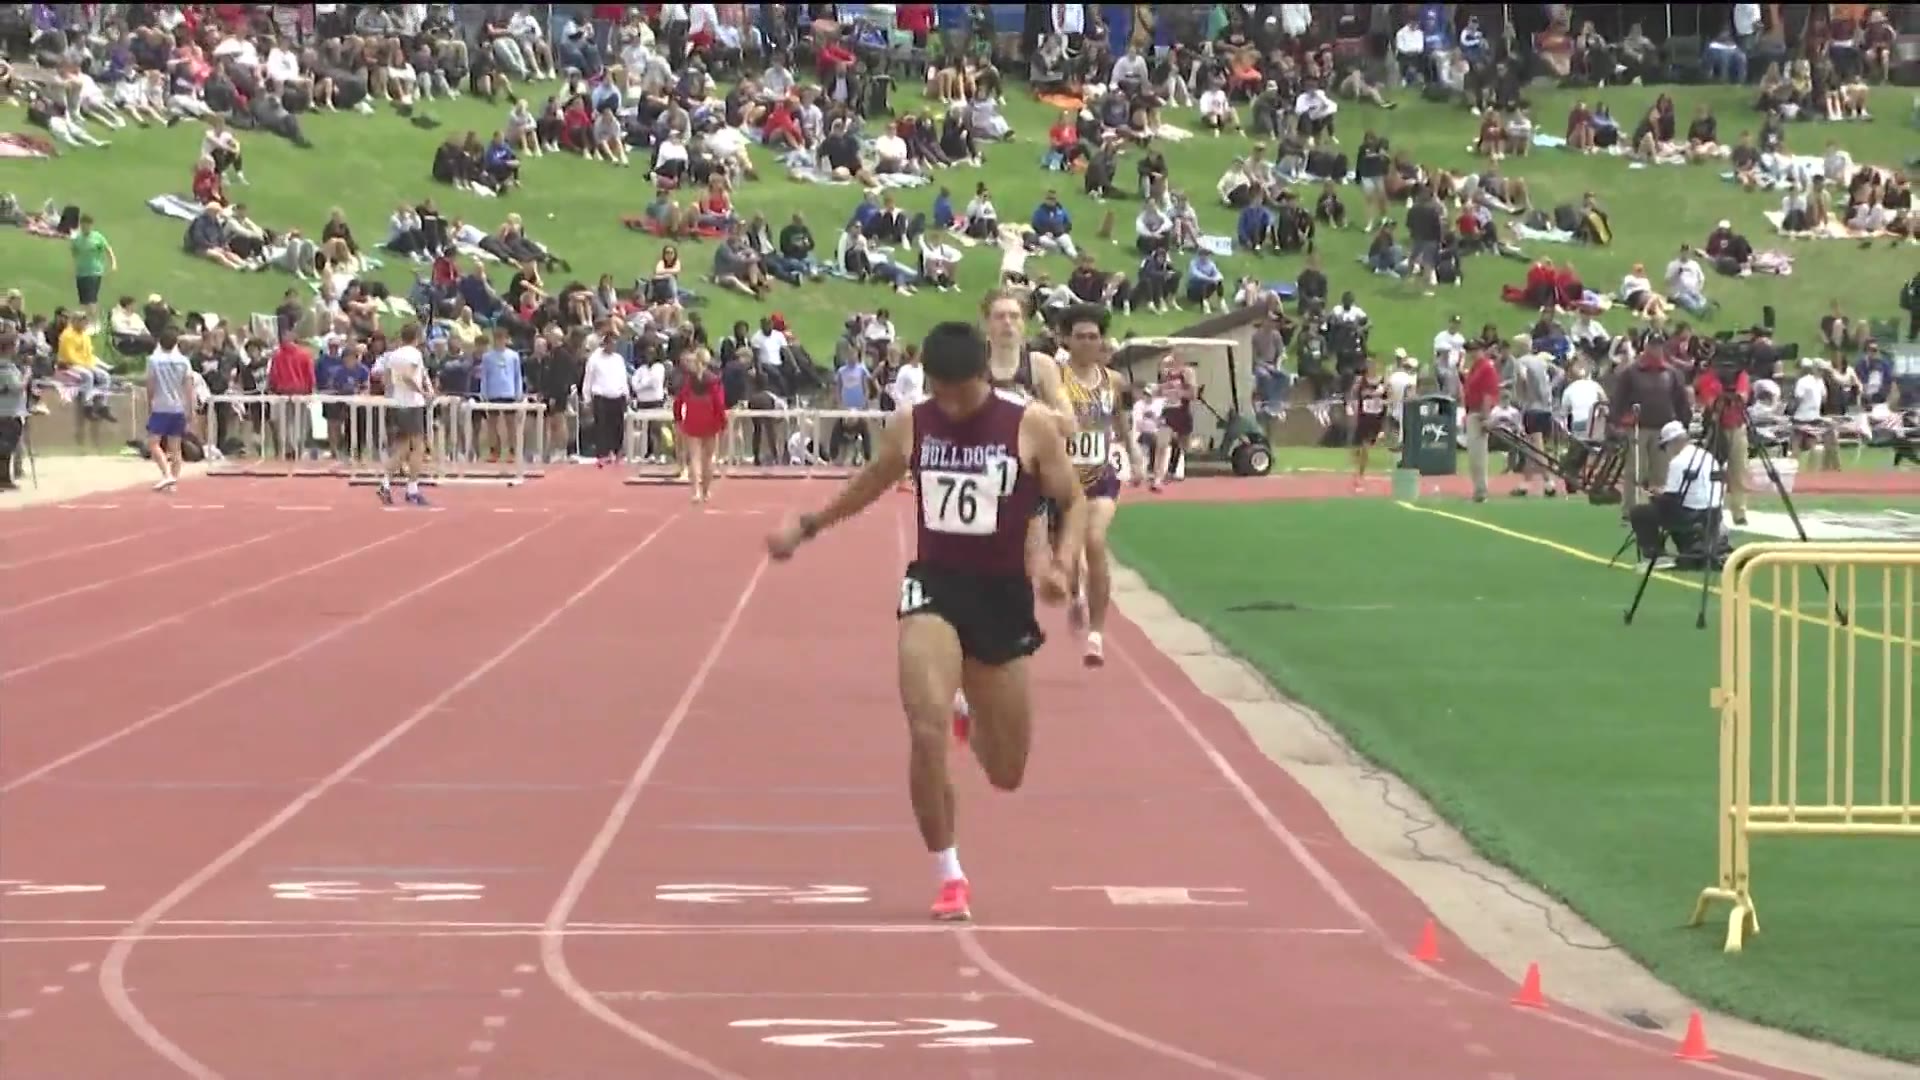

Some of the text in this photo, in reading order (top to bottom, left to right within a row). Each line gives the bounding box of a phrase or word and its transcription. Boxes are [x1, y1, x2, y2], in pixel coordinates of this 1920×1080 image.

[1066, 432, 1099, 458] 601
[996, 459, 1009, 493] 1
[1112, 451, 1122, 472] 3
[936, 475, 977, 524] 76
